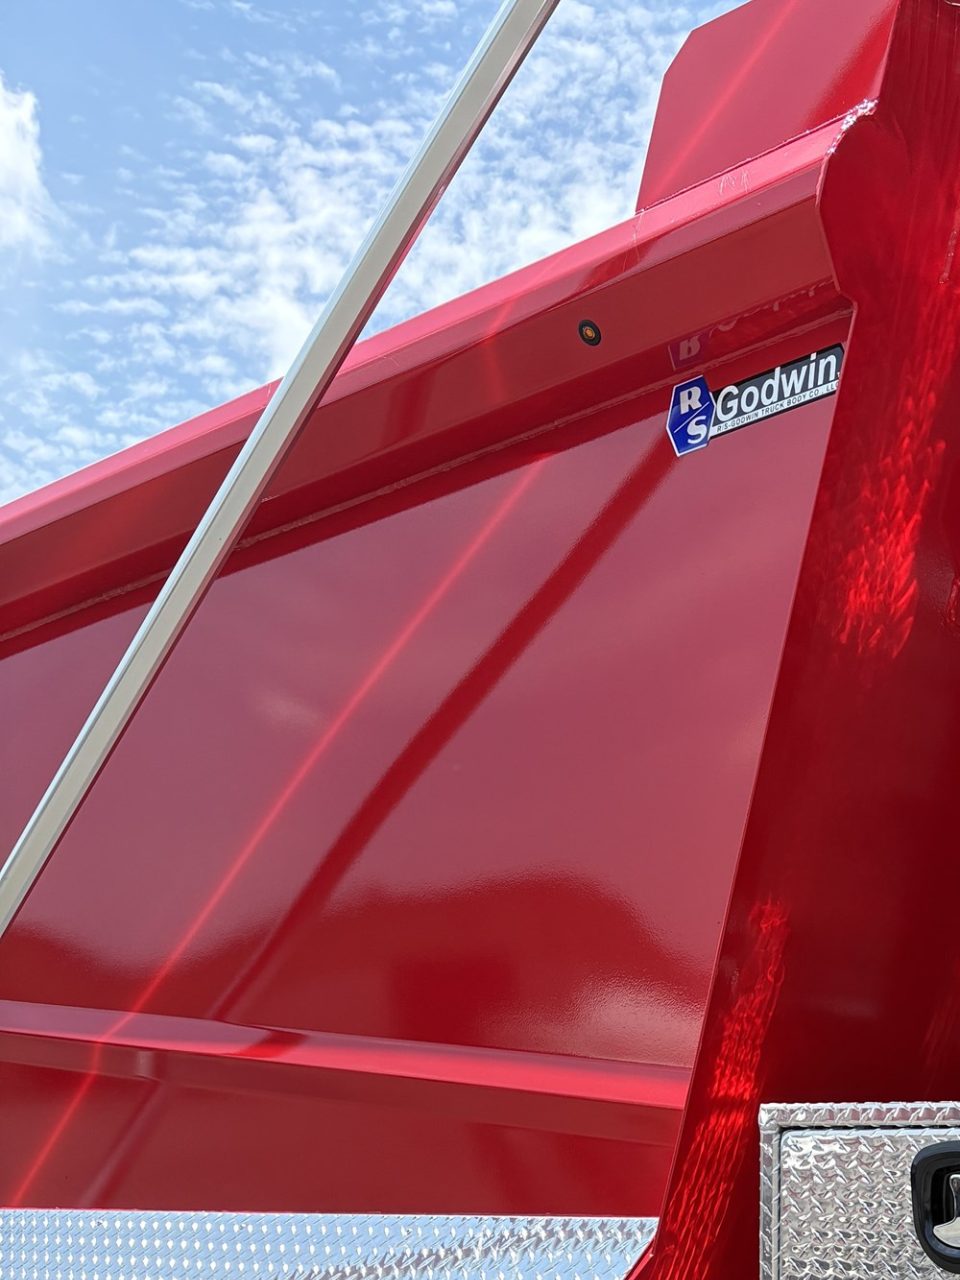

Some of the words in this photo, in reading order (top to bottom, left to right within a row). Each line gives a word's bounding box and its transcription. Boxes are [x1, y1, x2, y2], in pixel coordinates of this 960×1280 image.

[680, 386, 702, 415] R
[716, 352, 837, 422] Godwin
[761, 402, 784, 416] TRUCK
[786, 393, 807, 407] BODY
